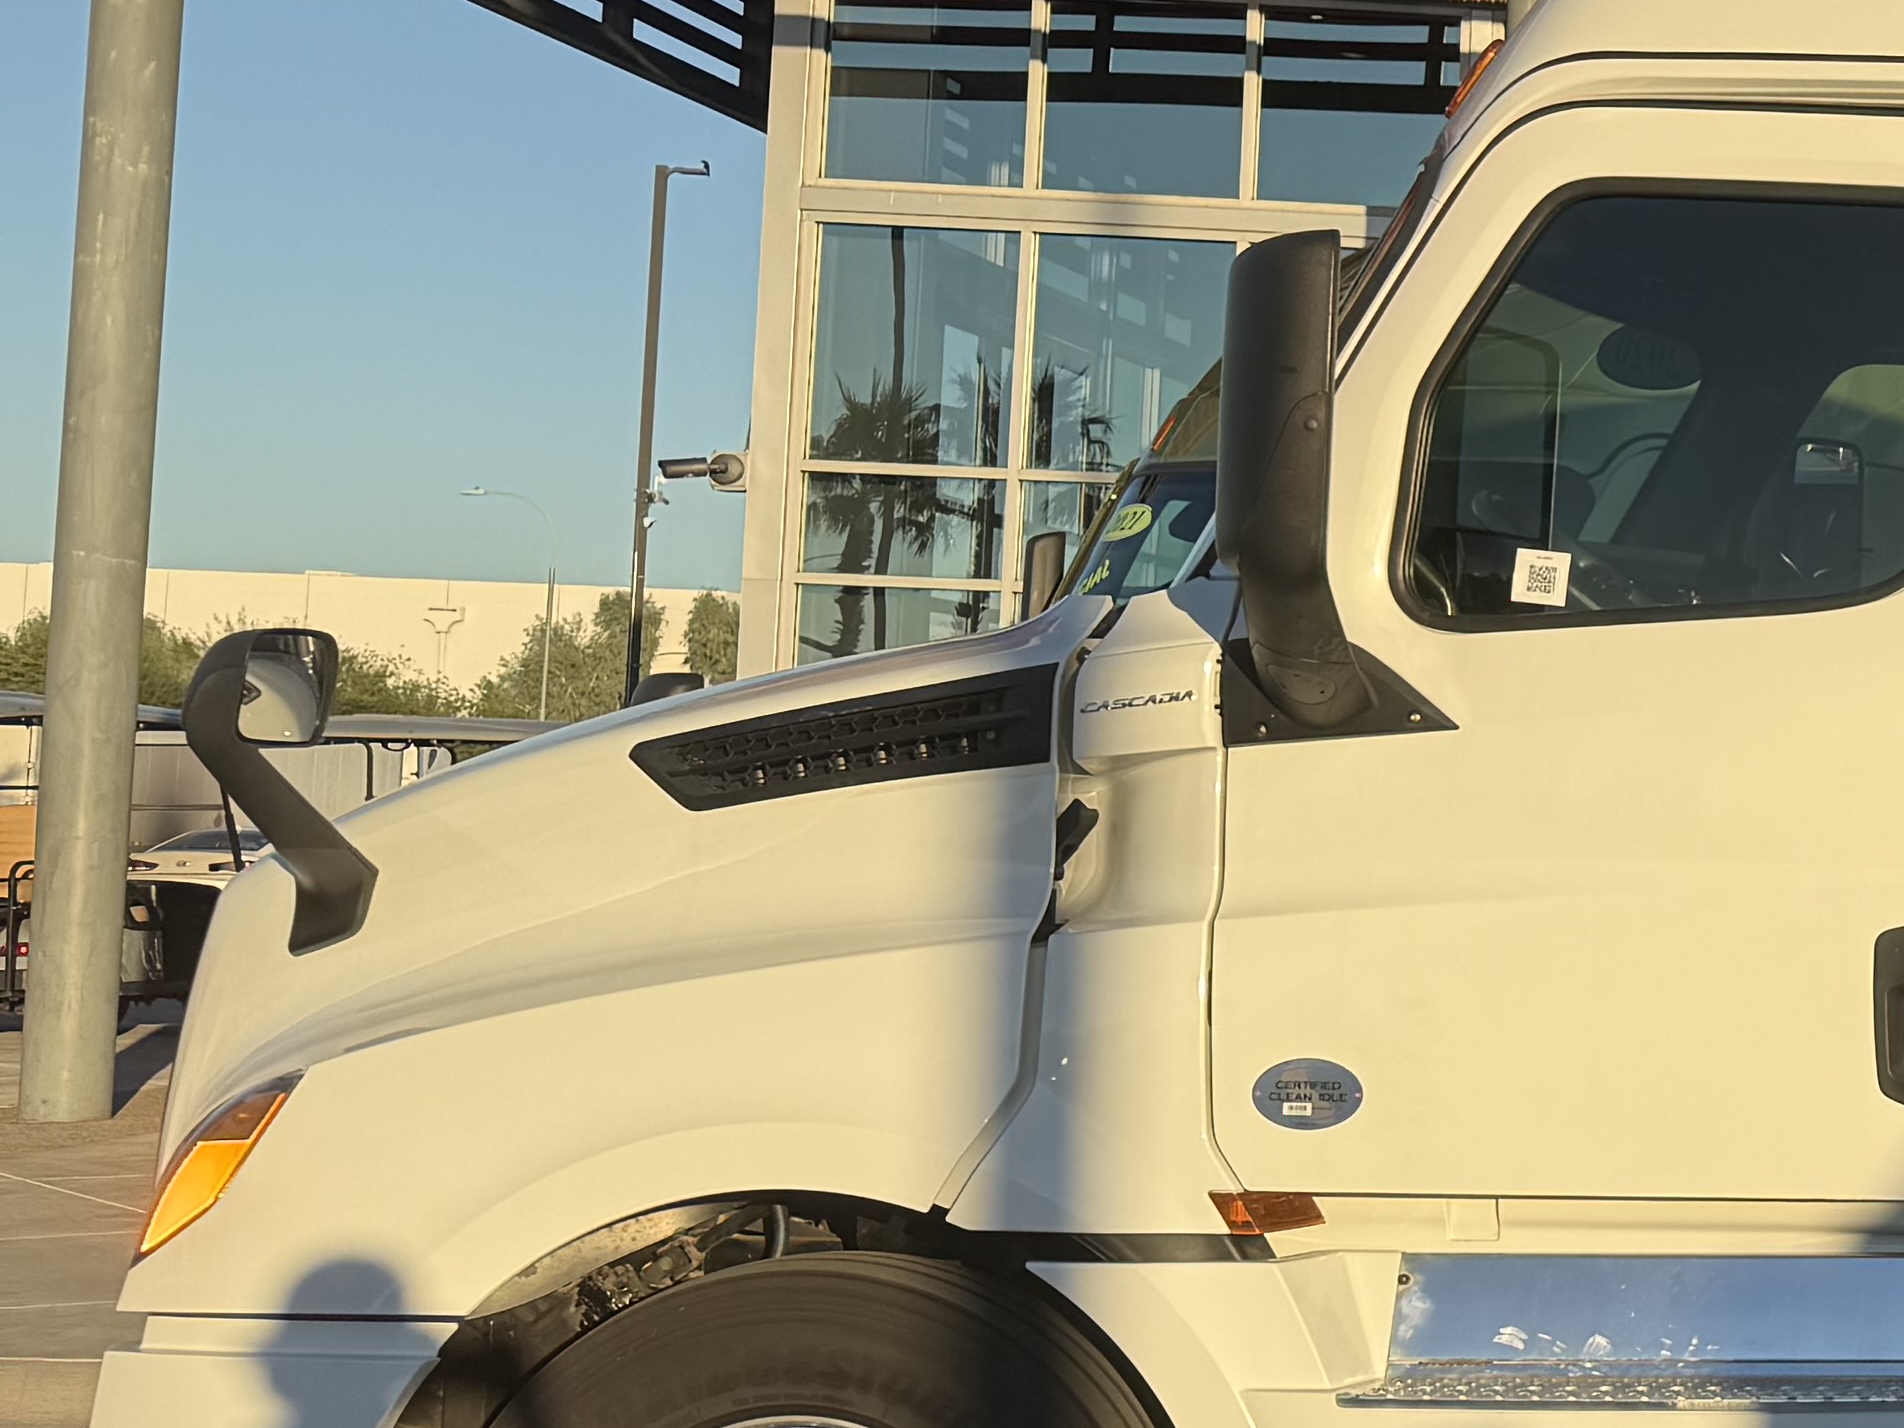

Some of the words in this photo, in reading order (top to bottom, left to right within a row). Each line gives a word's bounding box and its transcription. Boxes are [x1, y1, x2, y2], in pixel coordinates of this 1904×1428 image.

[1080, 690, 1195, 714] CASCADIA
[1275, 1080, 1342, 1091] CERTIFIED
[1268, 1092, 1313, 1102] CLEAN
[1318, 1092, 1348, 1103] IDLE
